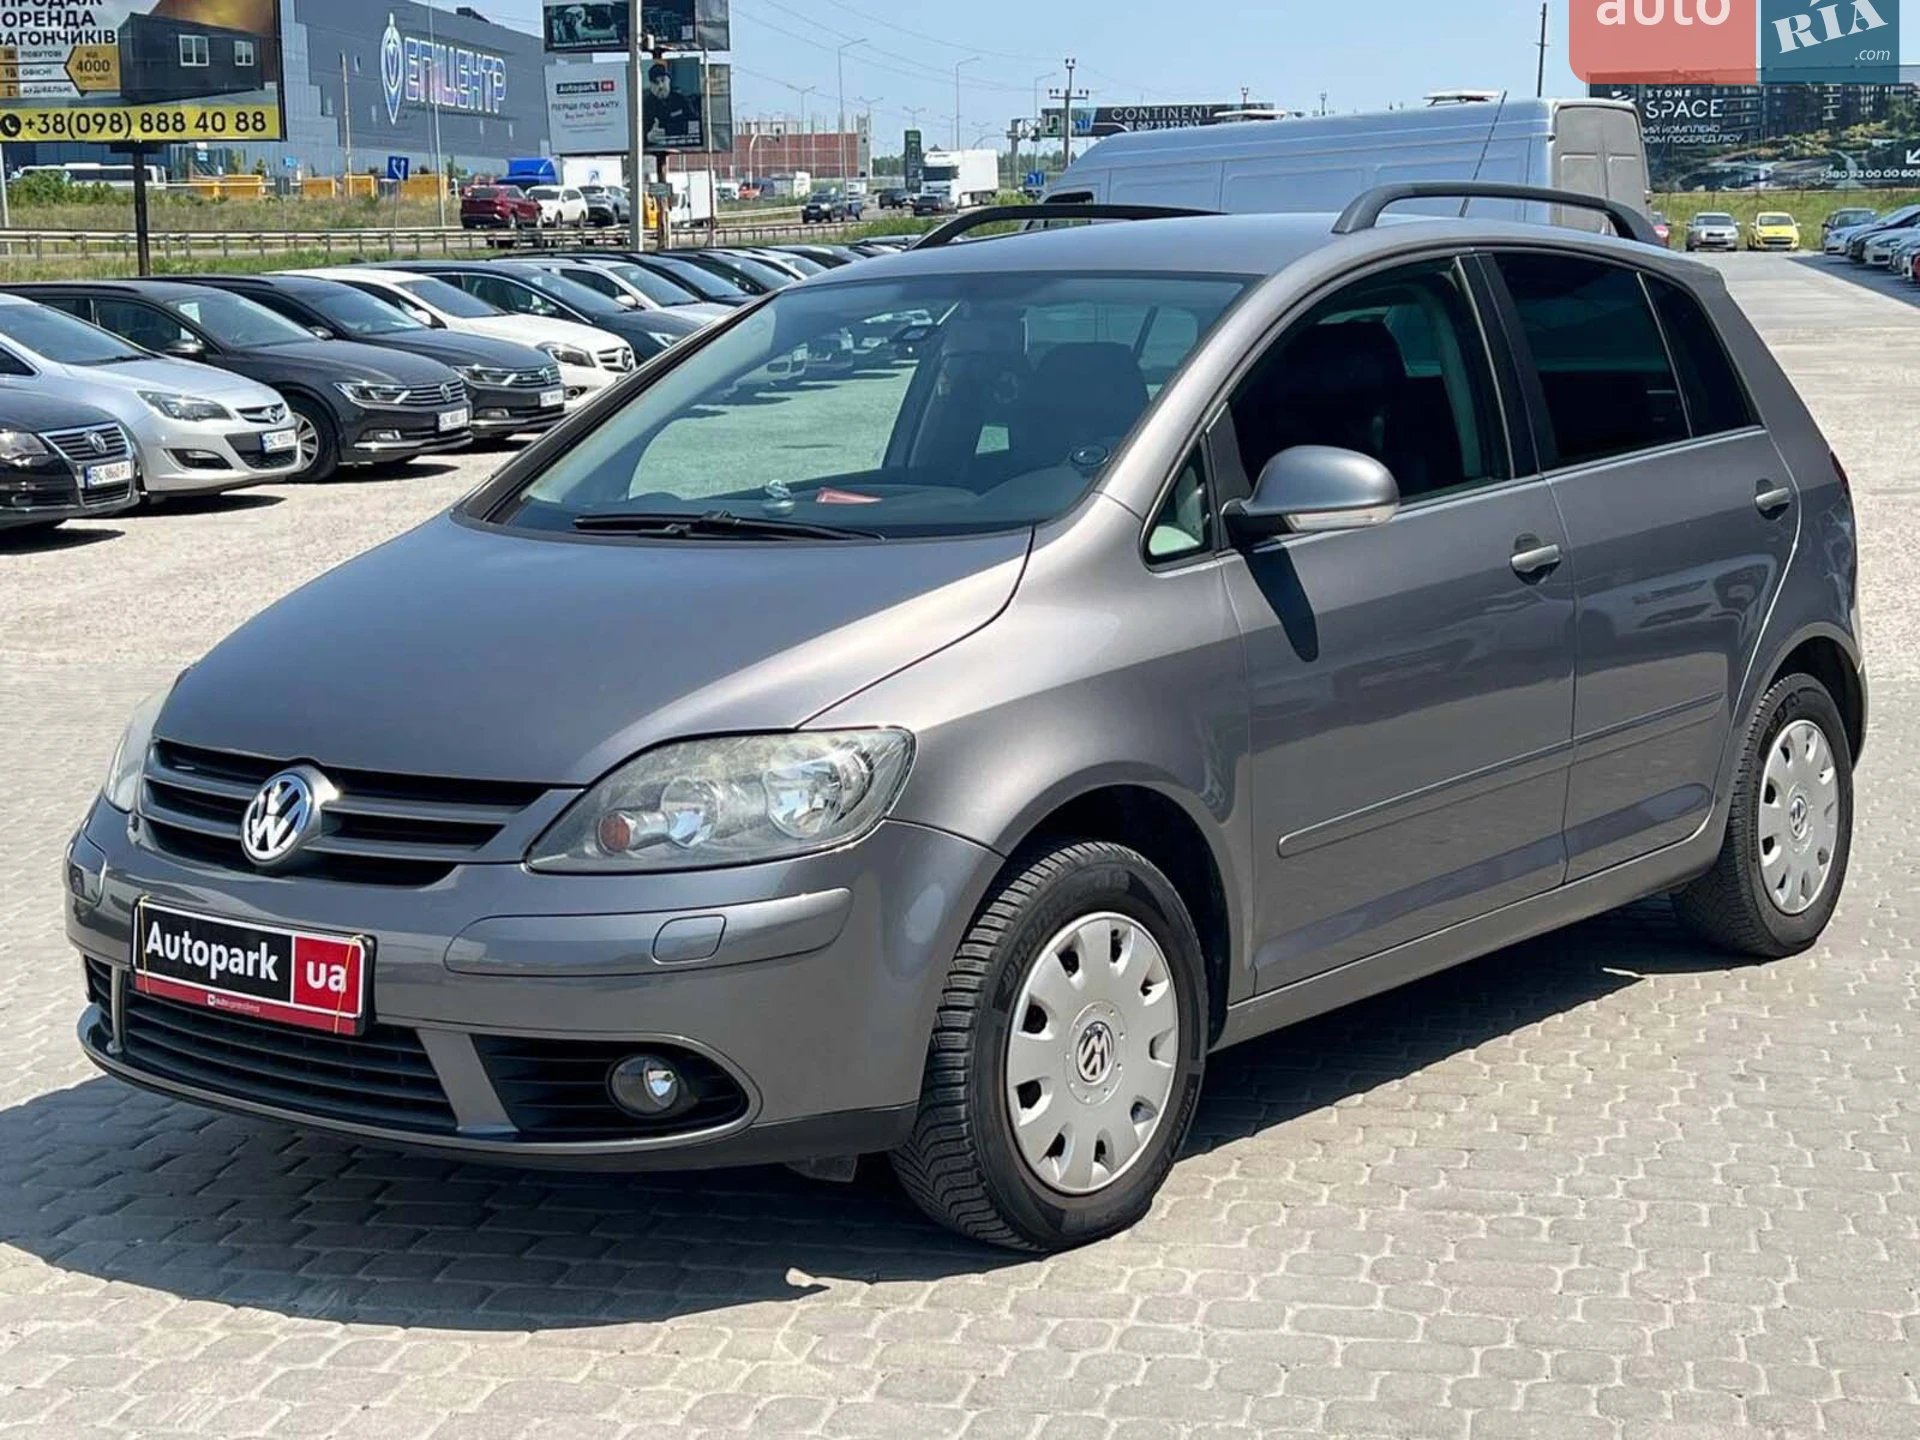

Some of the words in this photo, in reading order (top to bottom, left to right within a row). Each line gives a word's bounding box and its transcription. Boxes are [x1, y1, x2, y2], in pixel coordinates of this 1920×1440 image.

[2, 10, 96, 29] ОРЕНДА
[0, 30, 116, 45] АГОНЧИКІВ
[76, 59, 110, 72] 4000
[1646, 89, 1692, 98] STONE
[1111, 106, 1213, 120] CONTINENT
[1645, 99, 1723, 118] SPACE
[25, 112, 132, 139] +38(098)
[140, 112, 186, 133] 888
[195, 111, 226, 133] 40
[235, 111, 267, 133] 88
[145, 920, 279, 981] Autopark
[306, 960, 347, 992] ua
